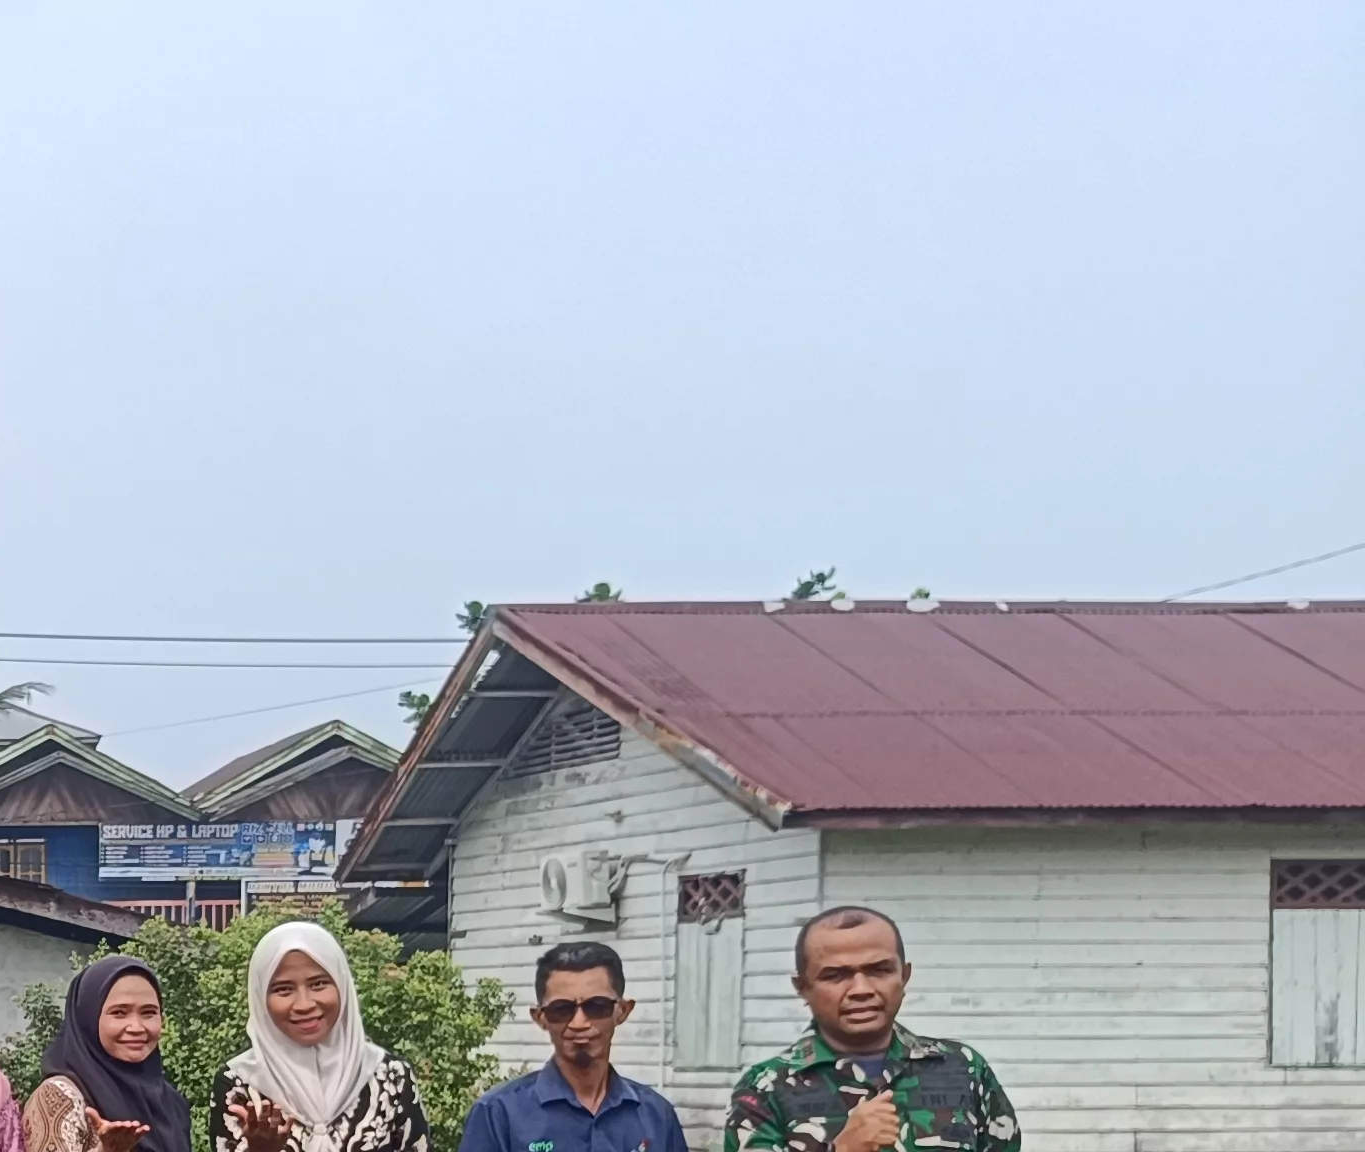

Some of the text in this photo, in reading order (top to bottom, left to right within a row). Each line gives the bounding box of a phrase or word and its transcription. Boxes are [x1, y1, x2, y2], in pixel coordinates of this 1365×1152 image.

[102, 823, 239, 839] SERVICE HP & LAPTOP
